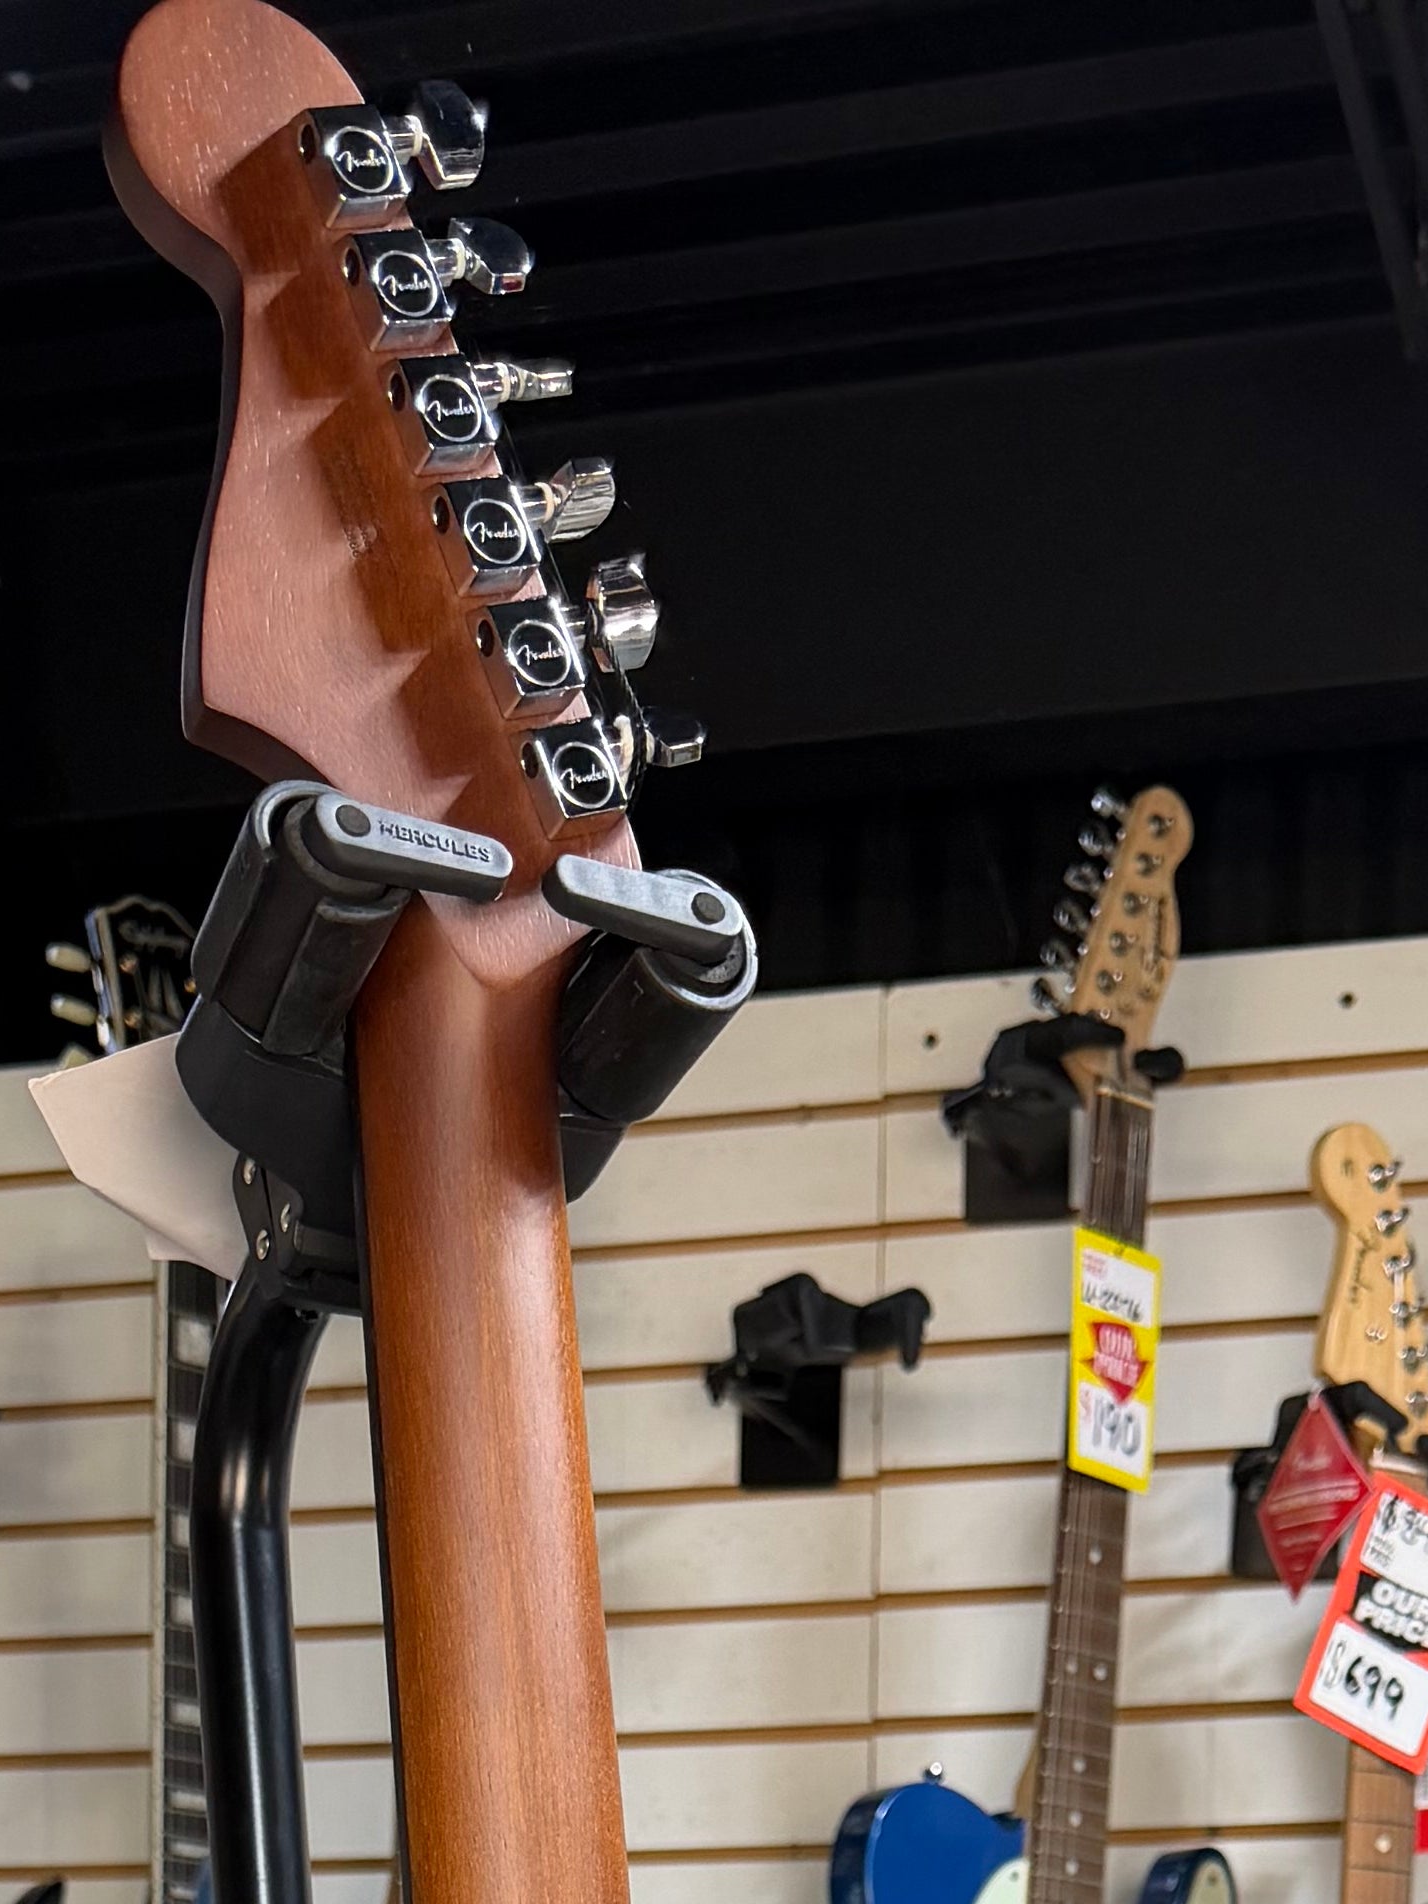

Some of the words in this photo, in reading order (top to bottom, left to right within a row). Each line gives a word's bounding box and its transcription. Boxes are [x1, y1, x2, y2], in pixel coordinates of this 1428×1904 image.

[337, 149, 386, 172] Fender
[381, 273, 431, 297] Fender
[427, 398, 475, 422] Fender
[470, 522, 520, 544] Fender
[516, 641, 565, 666] Fender
[560, 763, 608, 790] Fender
[378, 819, 491, 863] HERCULES
[1319, 1640, 1406, 1721] $699
